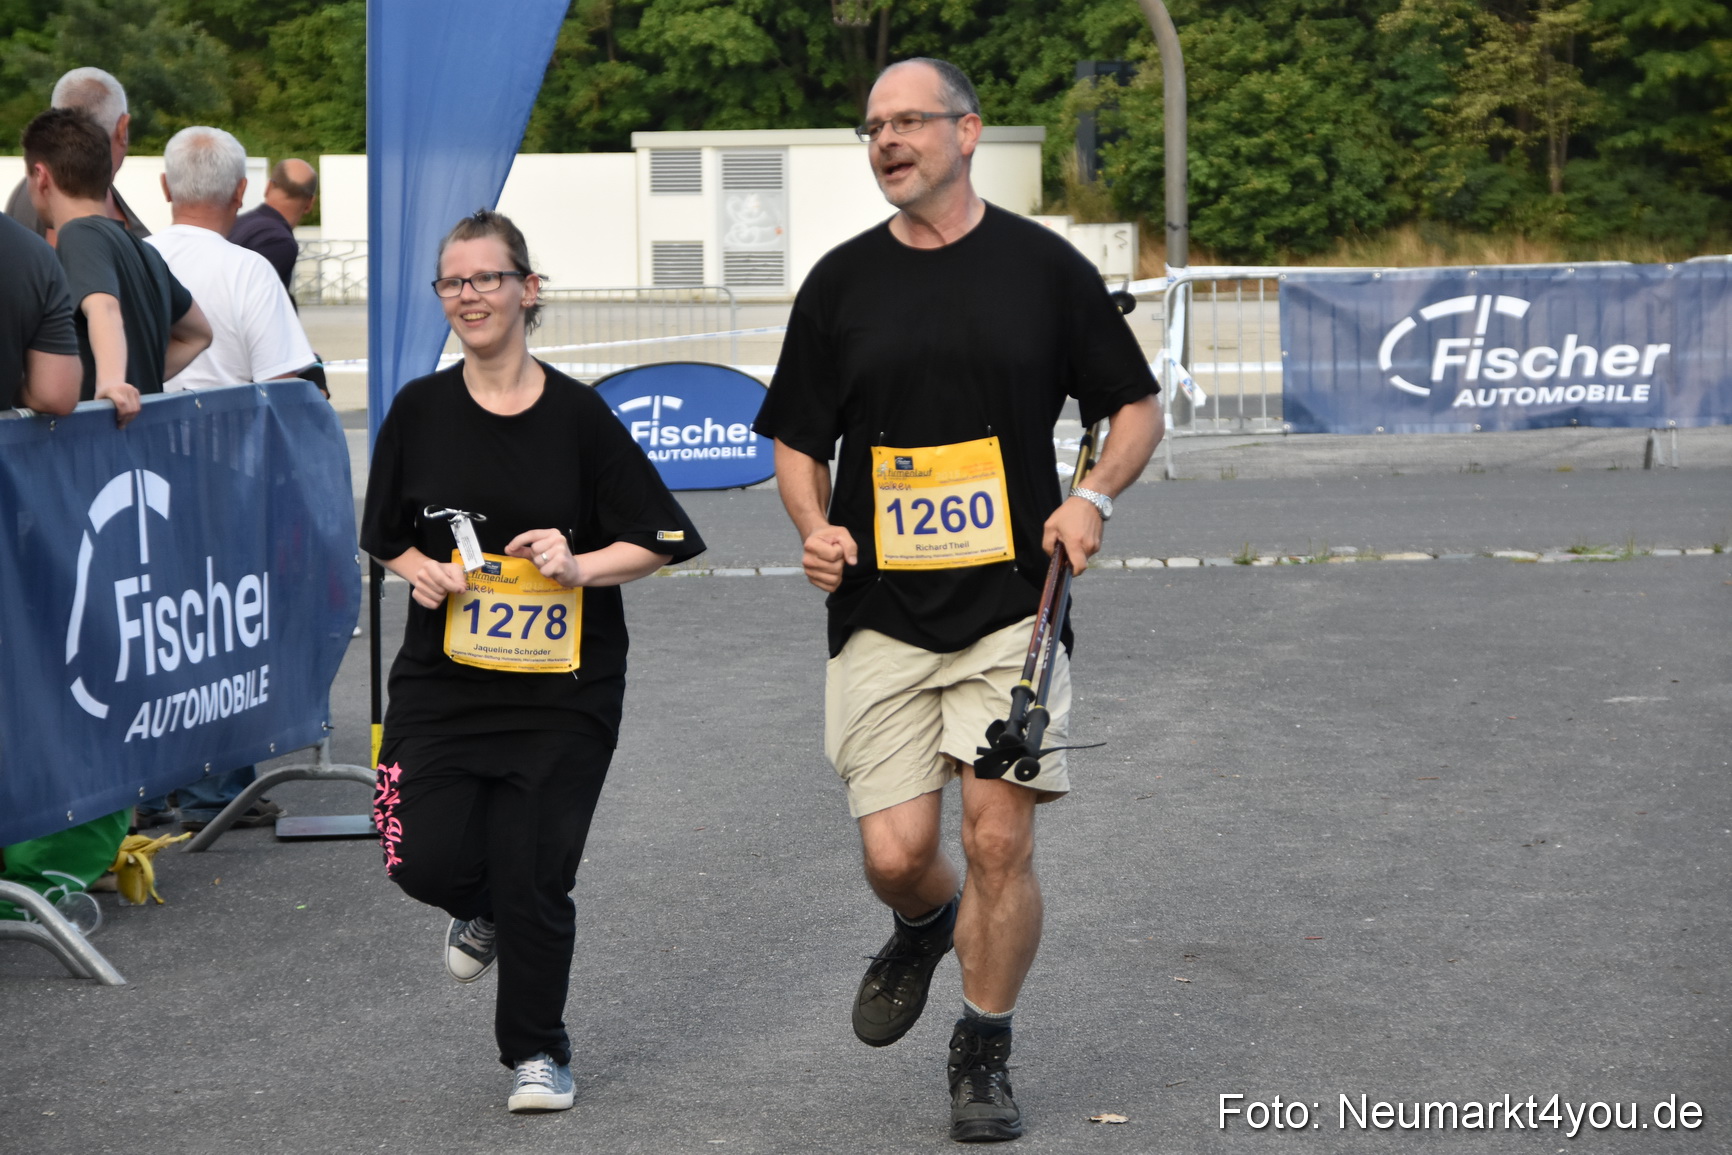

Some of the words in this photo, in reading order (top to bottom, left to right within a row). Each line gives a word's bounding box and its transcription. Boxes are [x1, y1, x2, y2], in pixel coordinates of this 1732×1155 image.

[1431, 333, 1671, 382] Fischer
[1453, 384, 1651, 408] AUTOMOBILE
[647, 446, 757, 463] AUTOMOBILE
[886, 490, 995, 536] 1260
[915, 543, 948, 552] Richard
[949, 541, 970, 550] Theil
[471, 570, 519, 585] firmenlauf
[466, 582, 494, 595] alken
[462, 598, 568, 641] 1278
[473, 643, 513, 655] Jaqueline
[514, 646, 552, 656] Schröder
[124, 664, 269, 743] AUTOMOBILE
